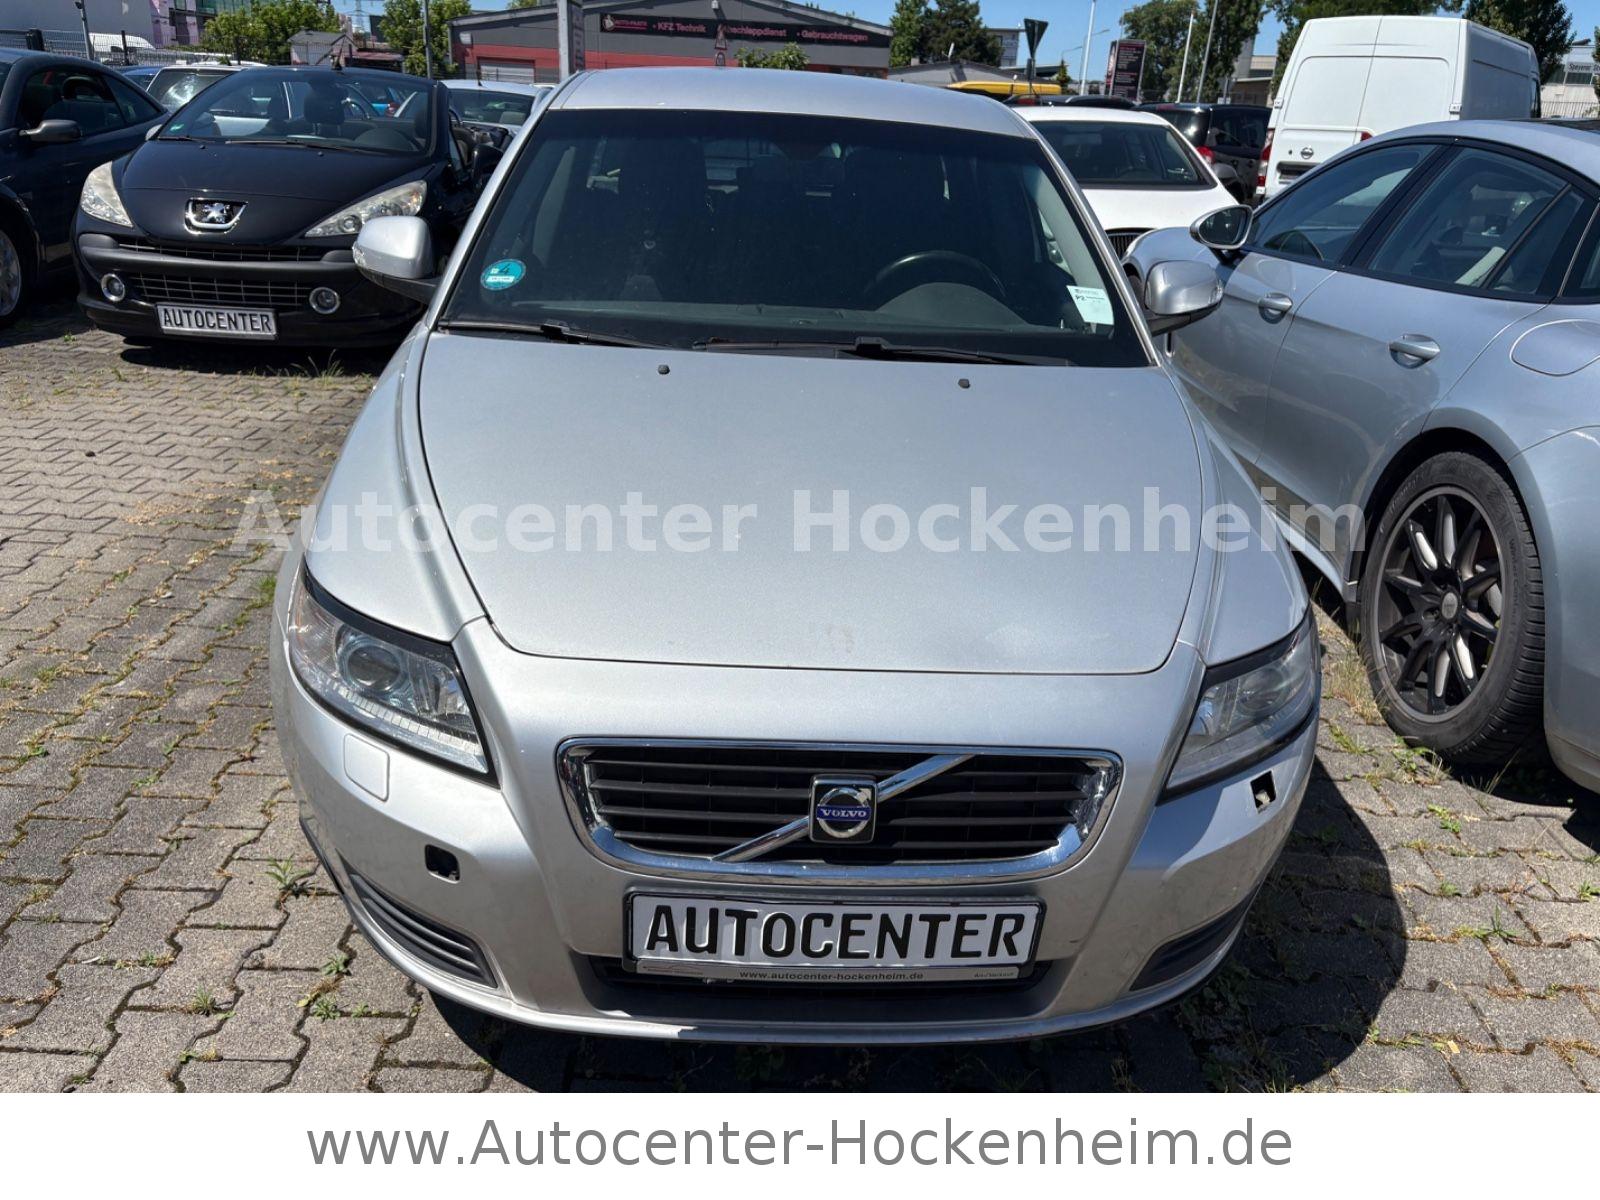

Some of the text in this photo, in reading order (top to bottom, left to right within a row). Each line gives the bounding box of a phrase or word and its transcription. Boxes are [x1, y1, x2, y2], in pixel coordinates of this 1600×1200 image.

[657, 22, 706, 33] KFZ Technik
[163, 308, 272, 332] AUTOCENTER
[820, 808, 868, 818] VOLVO
[645, 904, 1026, 960] AUTOCENTER
[739, 970, 924, 981] www.autocenter-hockenheim.de
